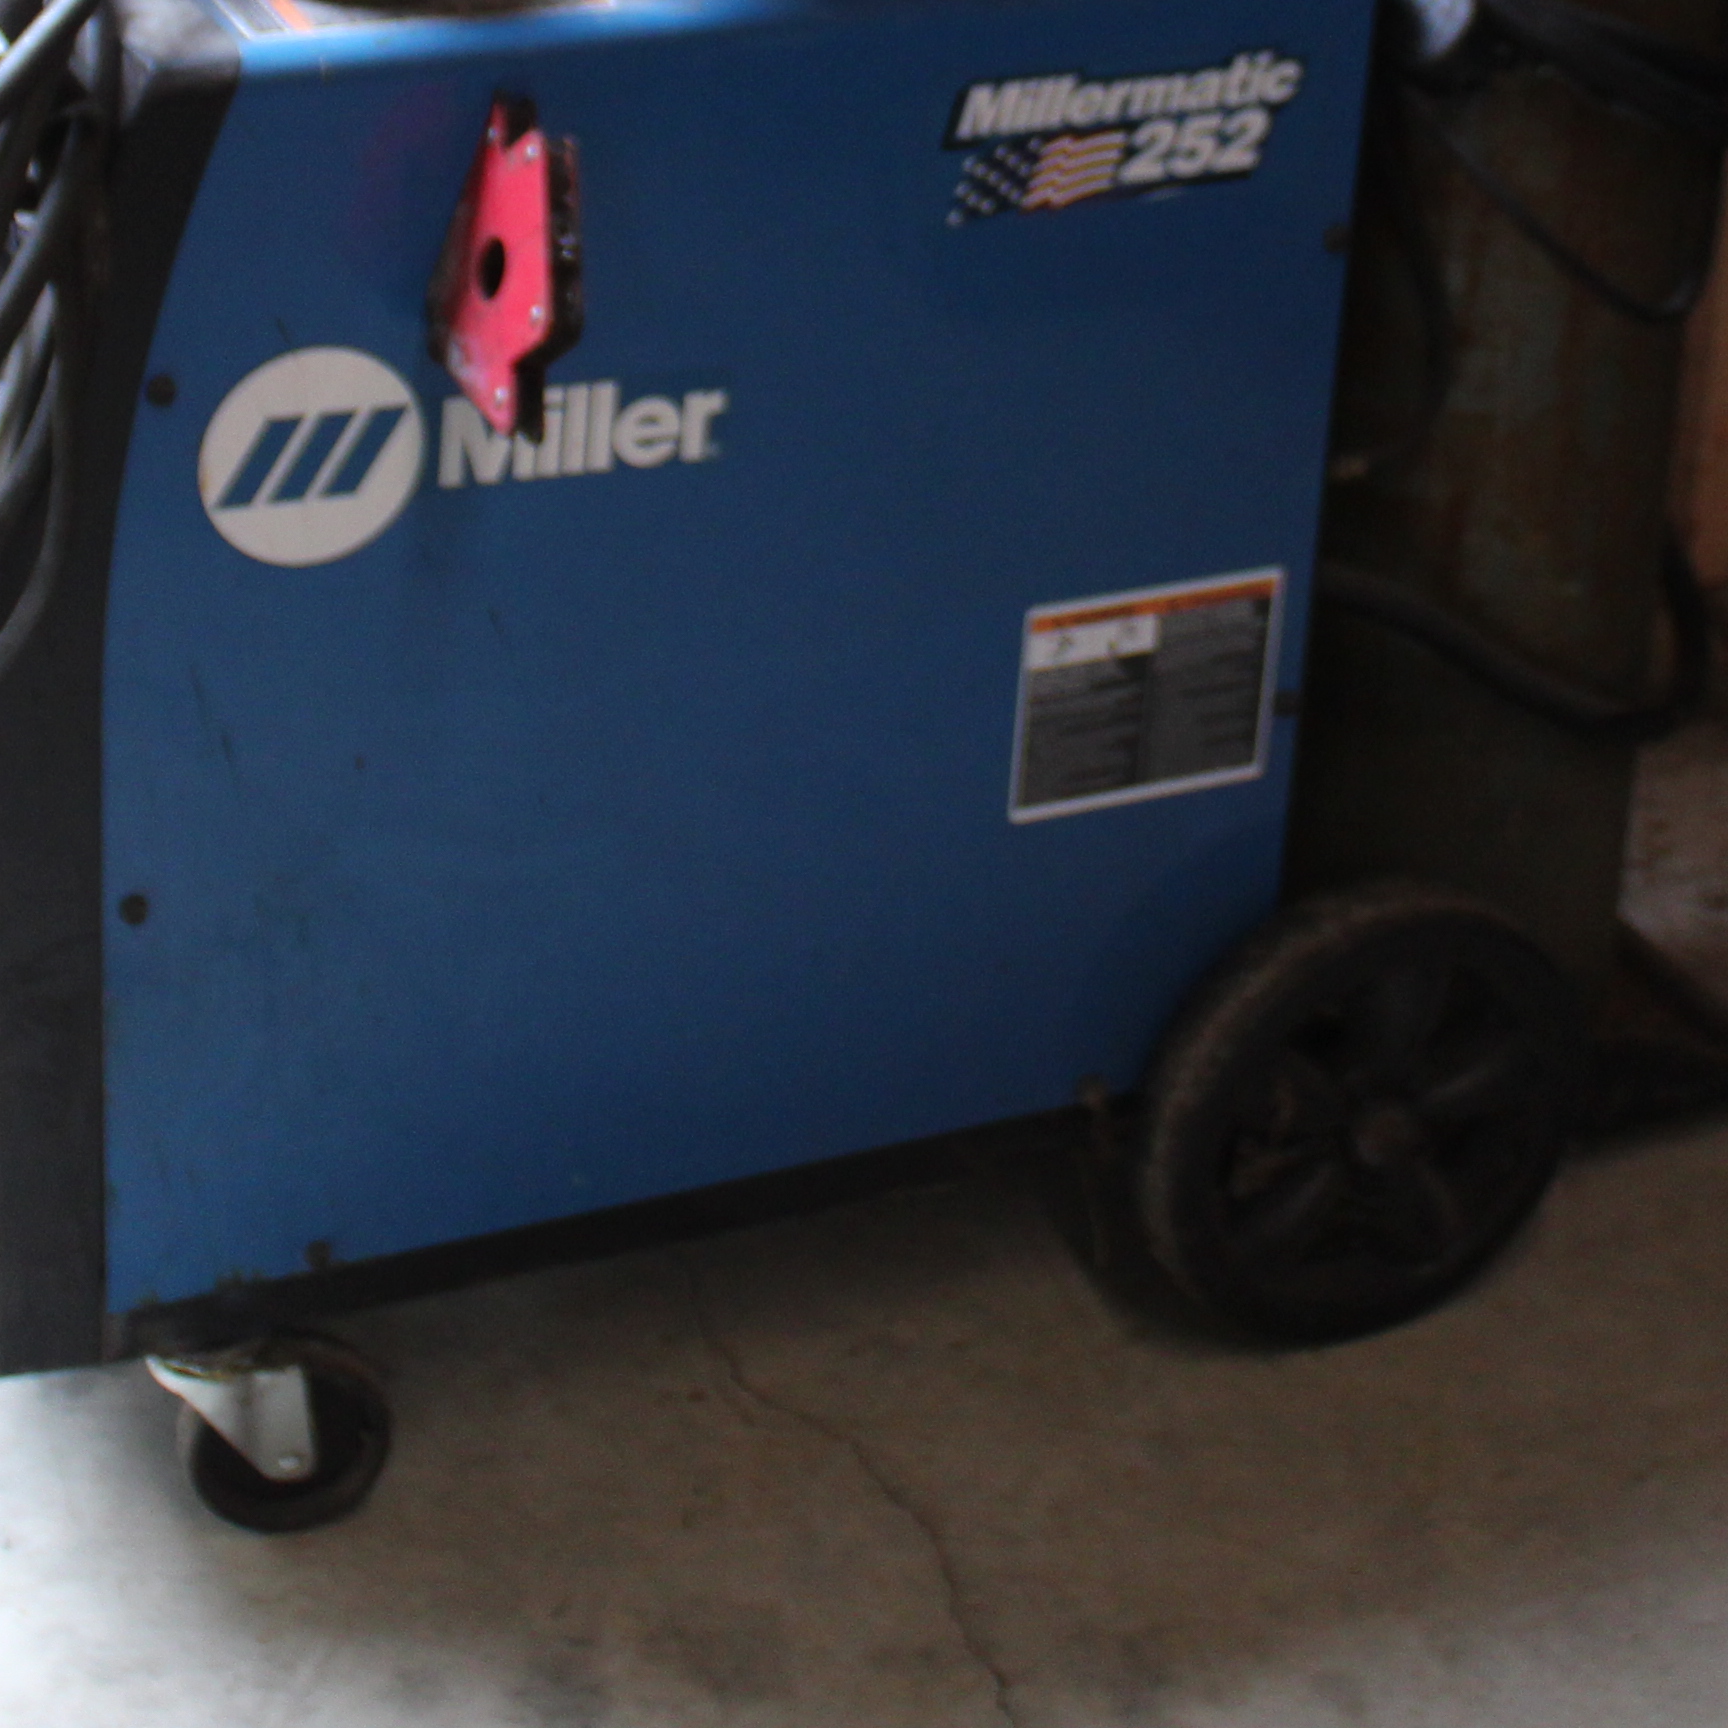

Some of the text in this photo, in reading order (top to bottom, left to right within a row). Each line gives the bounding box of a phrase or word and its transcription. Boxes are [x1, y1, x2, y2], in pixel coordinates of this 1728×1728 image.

[954, 48, 1302, 140] Millermatic
[1118, 108, 1271, 183] 252
[438, 379, 728, 489] Miller
